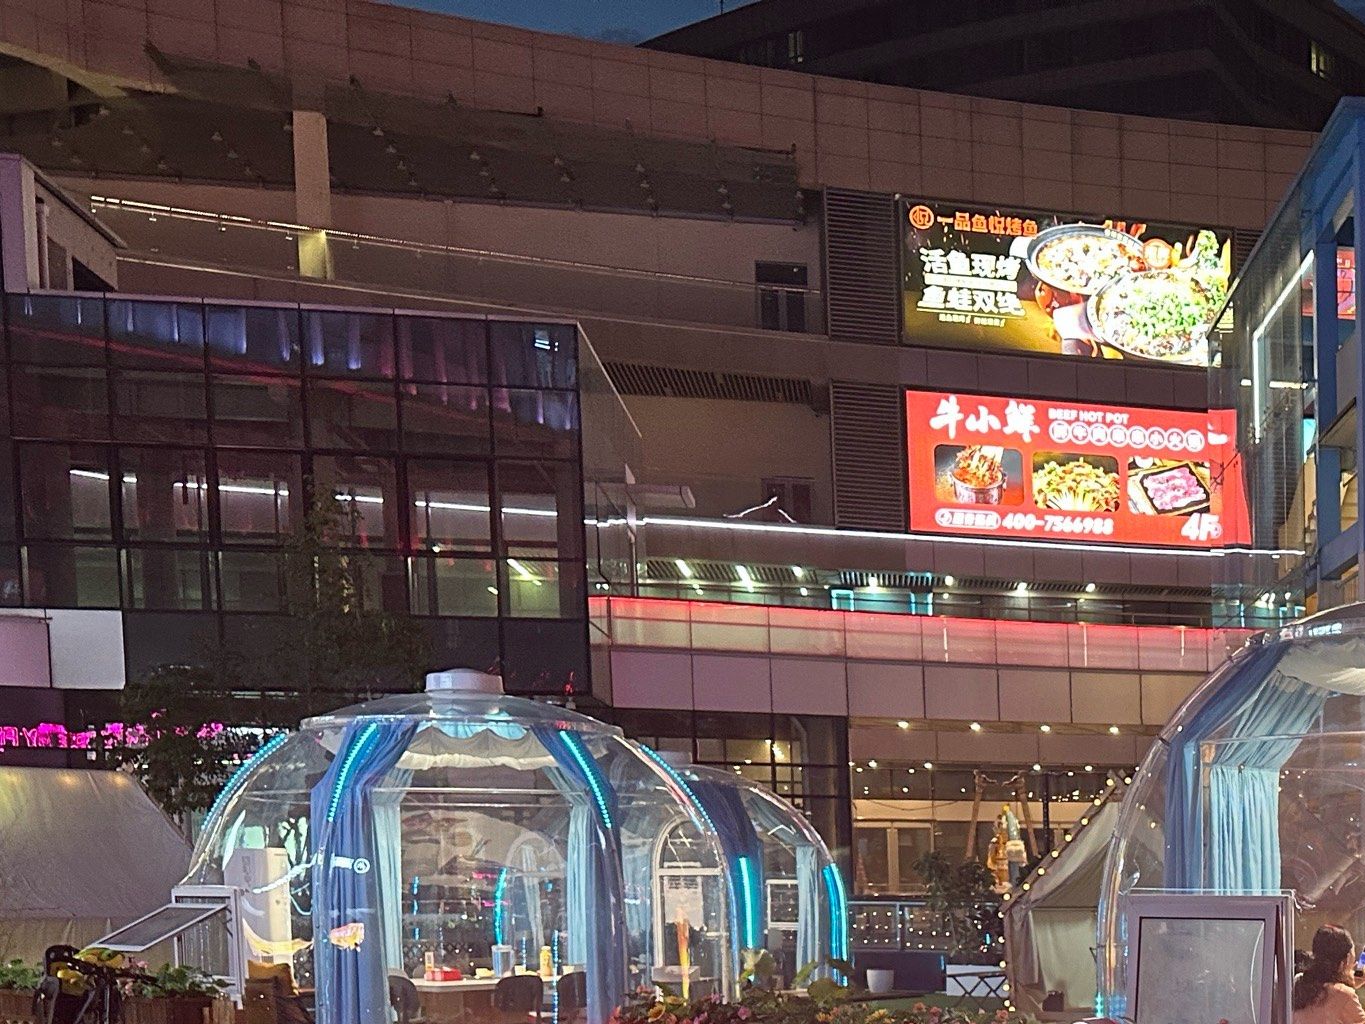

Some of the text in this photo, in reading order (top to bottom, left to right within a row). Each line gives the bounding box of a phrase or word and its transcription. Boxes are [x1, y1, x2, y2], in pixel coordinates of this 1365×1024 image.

[1048, 408, 1130, 424] BEEF HOT POT
